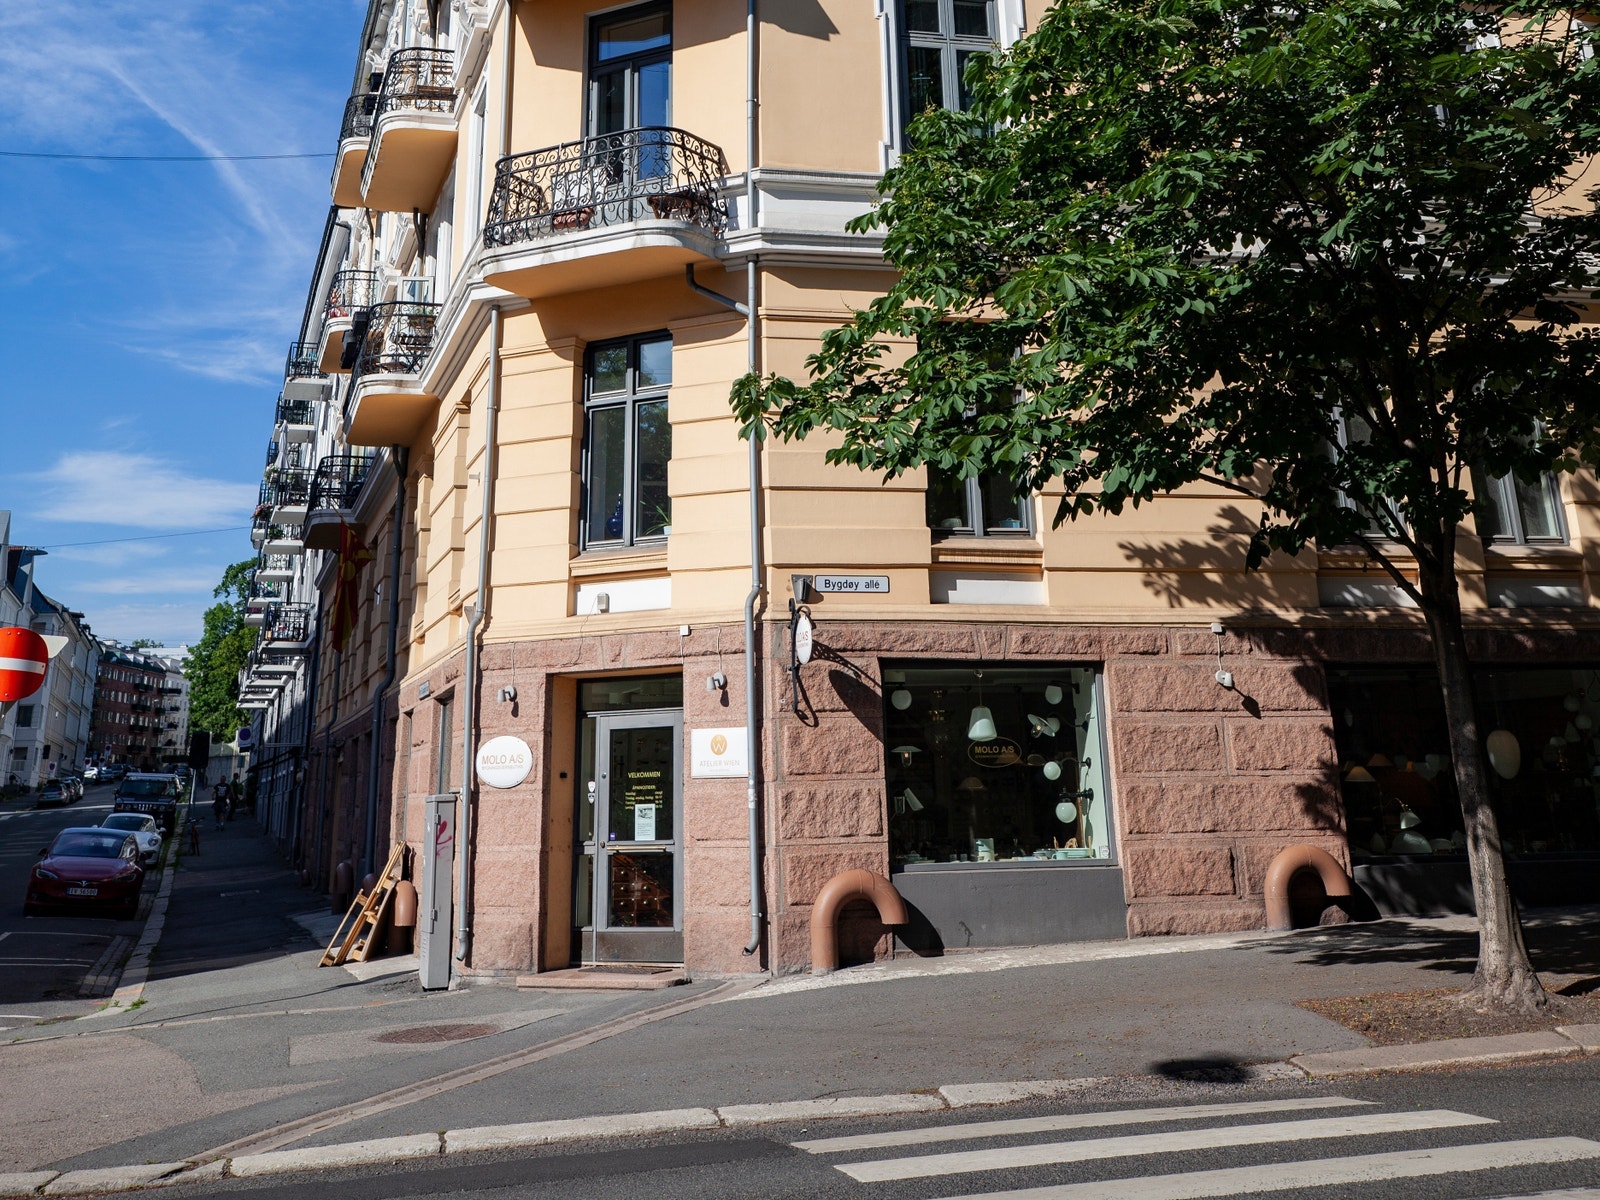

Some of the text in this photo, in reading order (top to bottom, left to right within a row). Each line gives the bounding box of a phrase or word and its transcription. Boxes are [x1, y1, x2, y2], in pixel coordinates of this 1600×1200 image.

[824, 579, 880, 590] Bygdøy allé
[975, 745, 999, 753] MOLO
[482, 753, 525, 764] MOLO A/S
[723, 759, 740, 767] WIEN
[627, 771, 661, 779] VELKOMMEN
